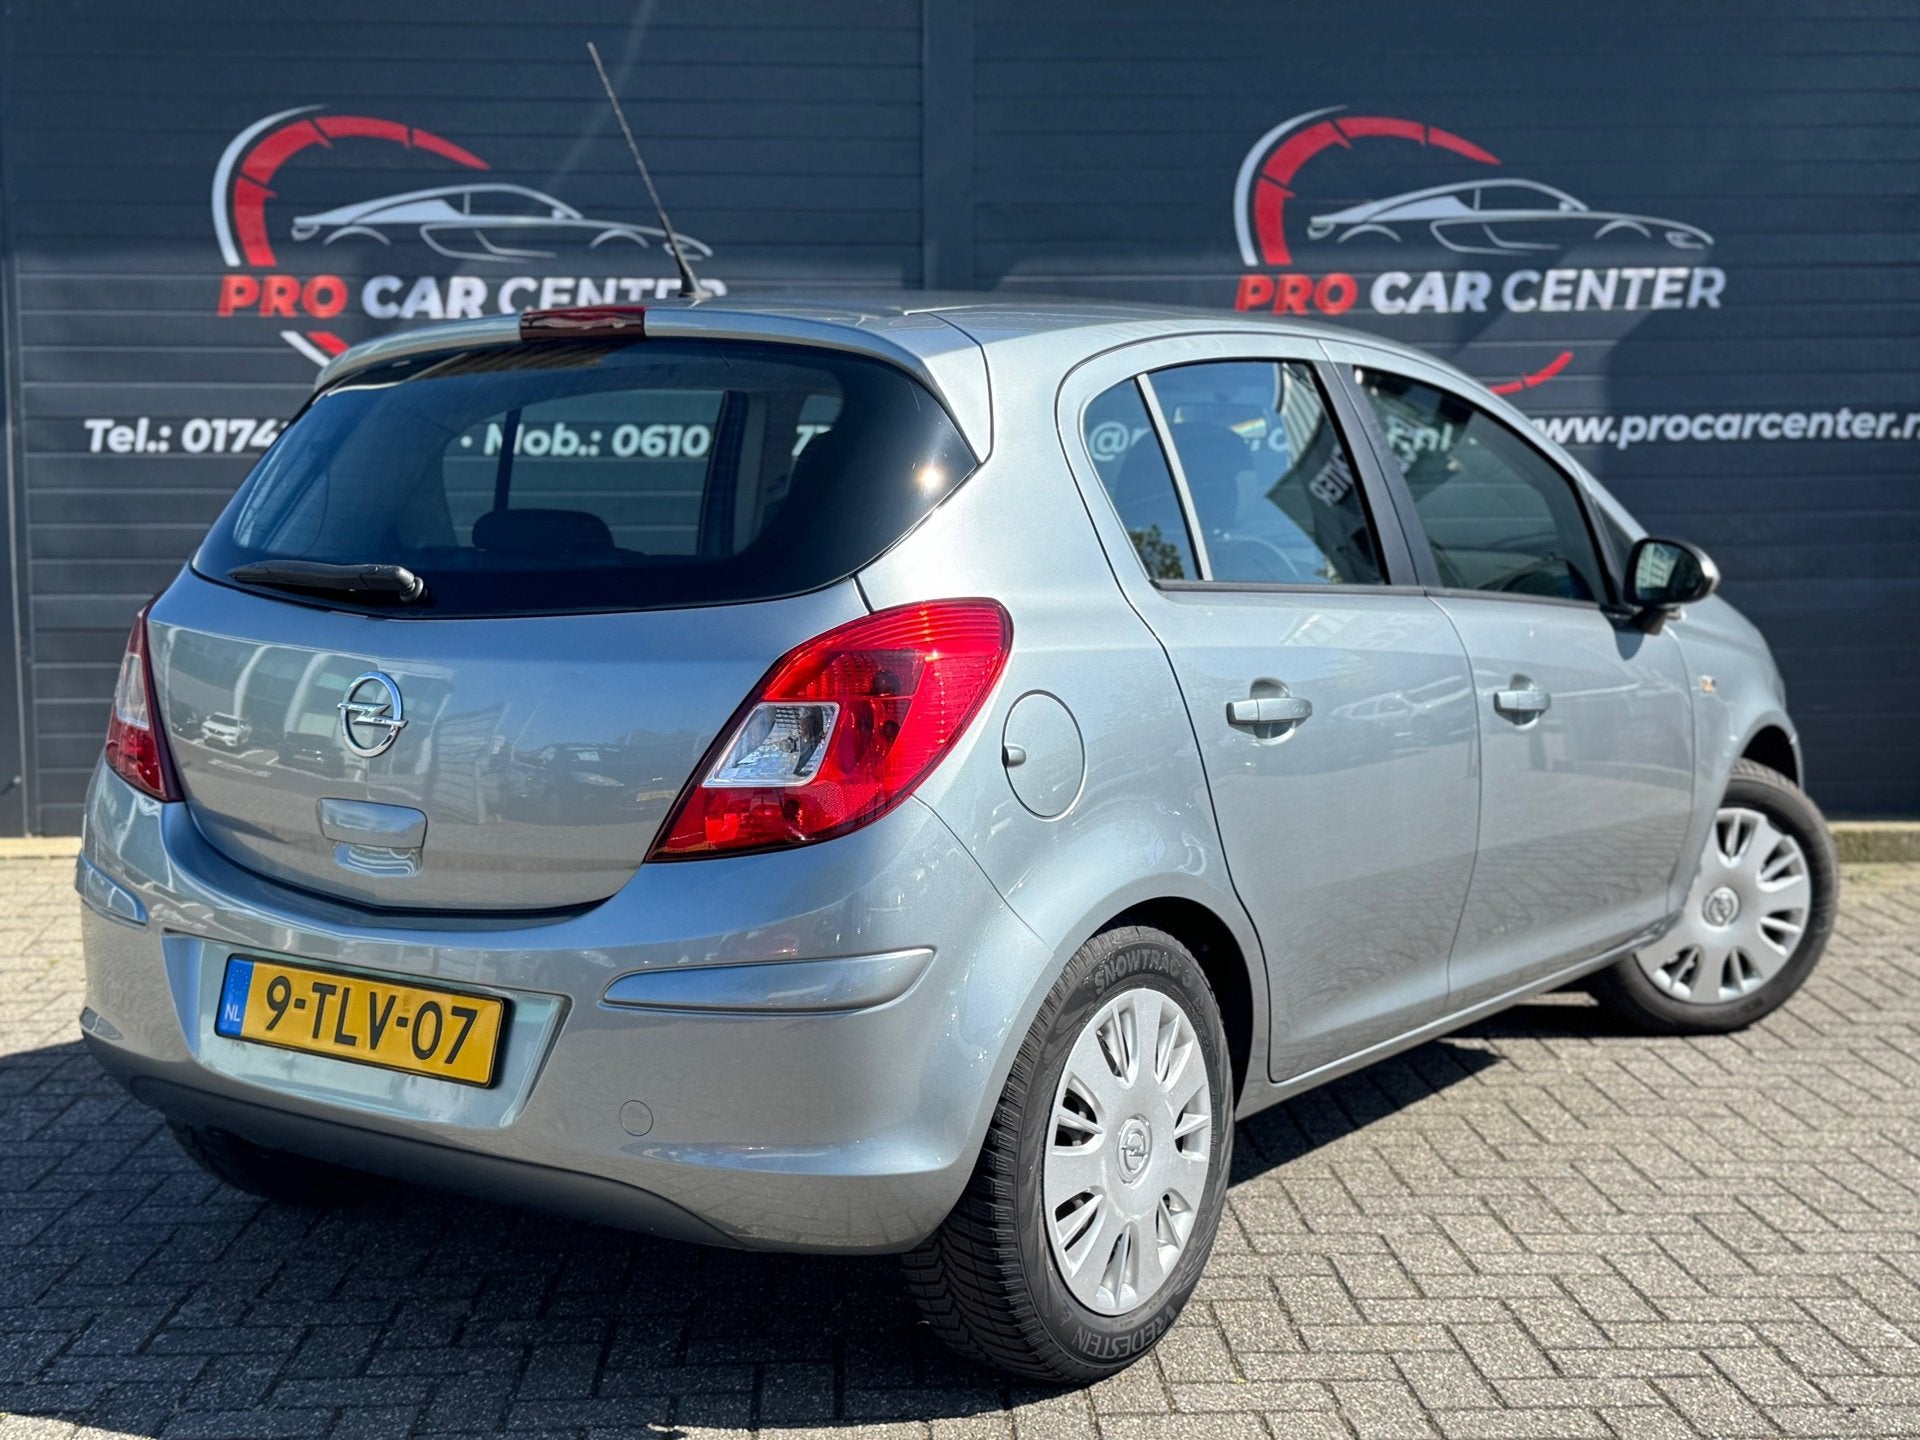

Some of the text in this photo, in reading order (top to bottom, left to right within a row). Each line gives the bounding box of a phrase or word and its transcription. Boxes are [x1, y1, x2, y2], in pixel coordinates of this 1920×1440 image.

[217, 274, 727, 319] PRO CAR CENT
[1235, 267, 1727, 316] PRO CAR CENTER
[84, 417, 289, 453] Tel.: 0174
[1531, 407, 1920, 450] ww.procarcenter.n
[1094, 948, 1181, 995] SNOWTRAC
[224, 1002, 241, 1022] NL
[266, 974, 478, 1065] 9-TLV-07
[1071, 1304, 1177, 1359] VREDESTEIN
